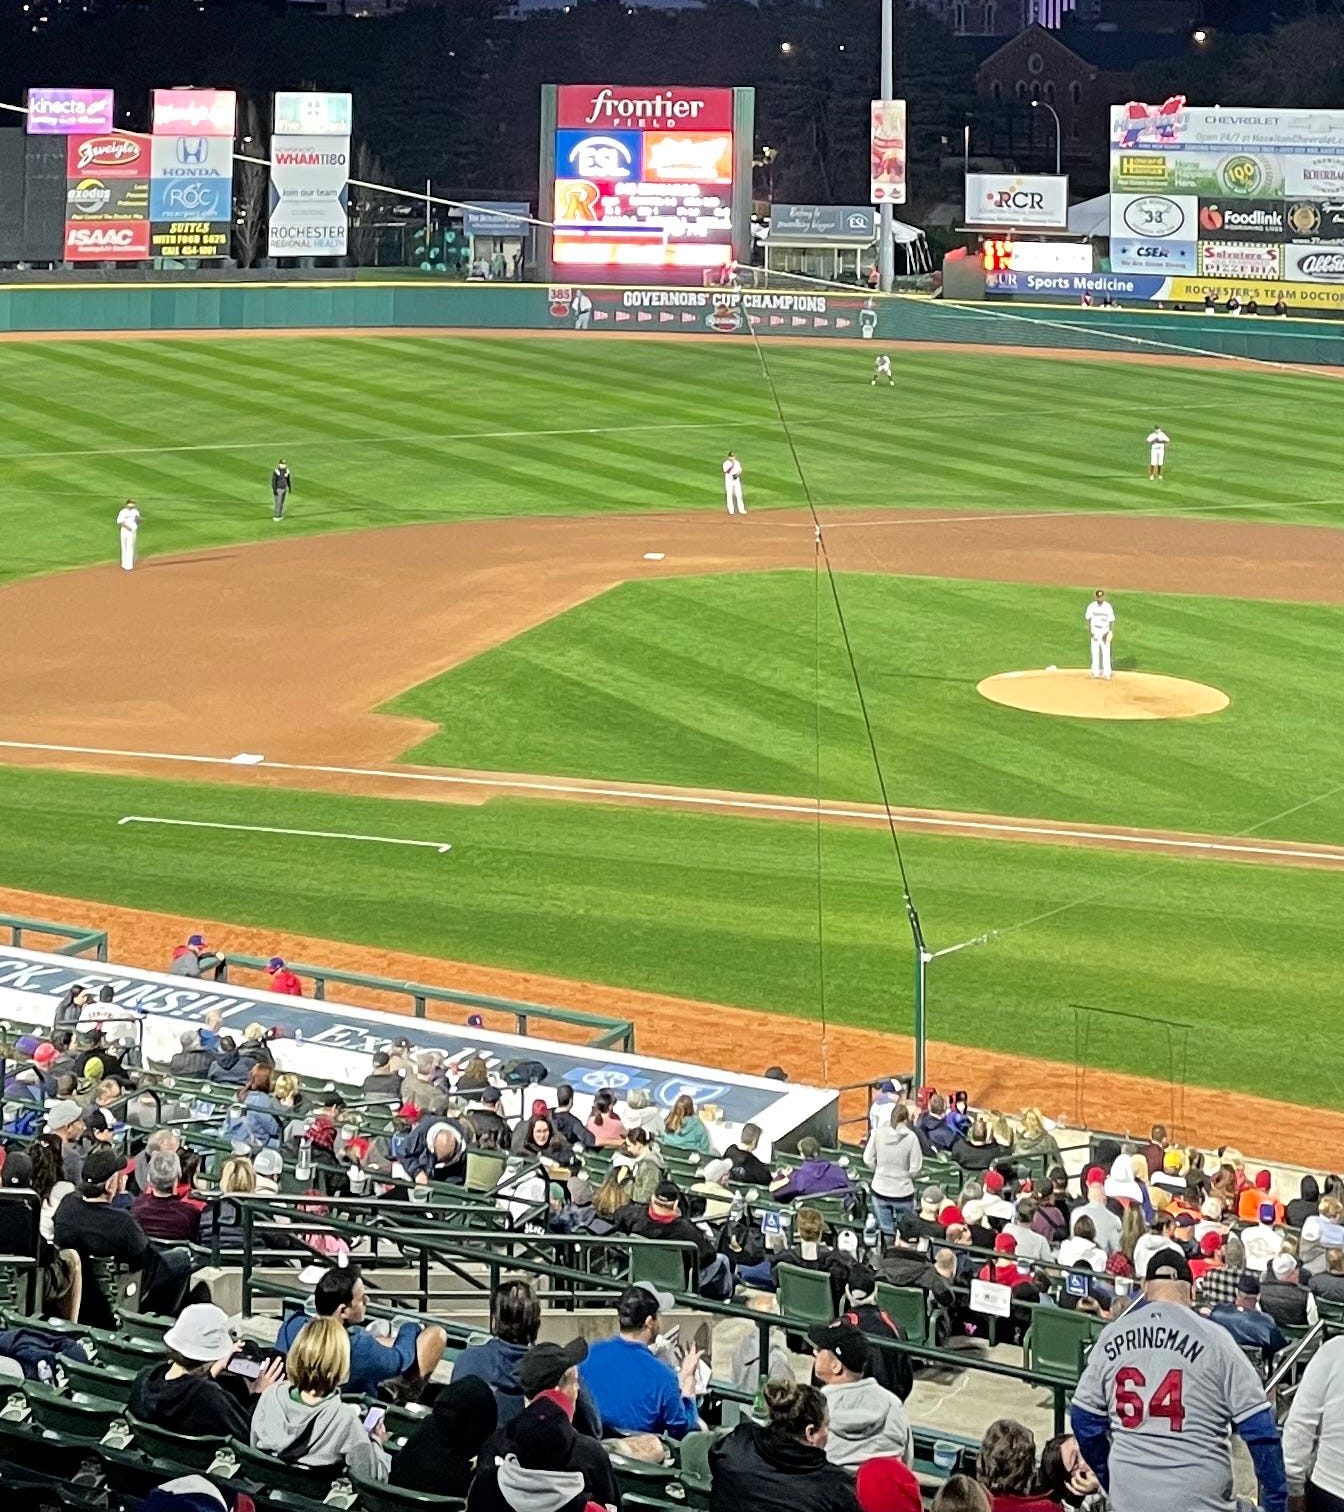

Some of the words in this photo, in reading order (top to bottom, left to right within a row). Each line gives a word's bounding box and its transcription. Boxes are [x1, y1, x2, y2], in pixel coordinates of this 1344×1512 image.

[30, 97, 86, 114] kinecta
[585, 88, 705, 124] frontier
[613, 118, 676, 128] FIELD
[1204, 114, 1280, 126] CHEVROLET
[162, 167, 221, 177] HONDA
[1228, 162, 1254, 183] 100
[67, 189, 111, 200] exodus
[170, 184, 211, 209] ROC
[282, 188, 299, 197] Join
[300, 189, 314, 197] our
[316, 188, 338, 197] team
[997, 191, 1044, 209] RCR
[849, 218, 867, 229] ESL
[1224, 209, 1283, 226] Foodlink
[67, 228, 134, 246] ISAAC
[270, 226, 345, 239] ROCHESTER
[270, 239, 312, 248] REGIONAL
[313, 239, 345, 248] HEALTH
[1136, 246, 1170, 258] CSEA
[1205, 263, 1278, 275] PIZZERIA
[1027, 275, 1070, 290] Sports
[1073, 276, 1134, 292] Medicine
[1185, 284, 1260, 298] ROCHESTER'S
[1264, 289, 1298, 300] TEAM
[623, 291, 711, 307] GOVERNORS'
[712, 293, 741, 307] CUP
[742, 296, 827, 313] CHAMPIONS
[1104, 1325, 1205, 1364] SPRINGMAN
[1115, 1365, 1186, 1433] 64
